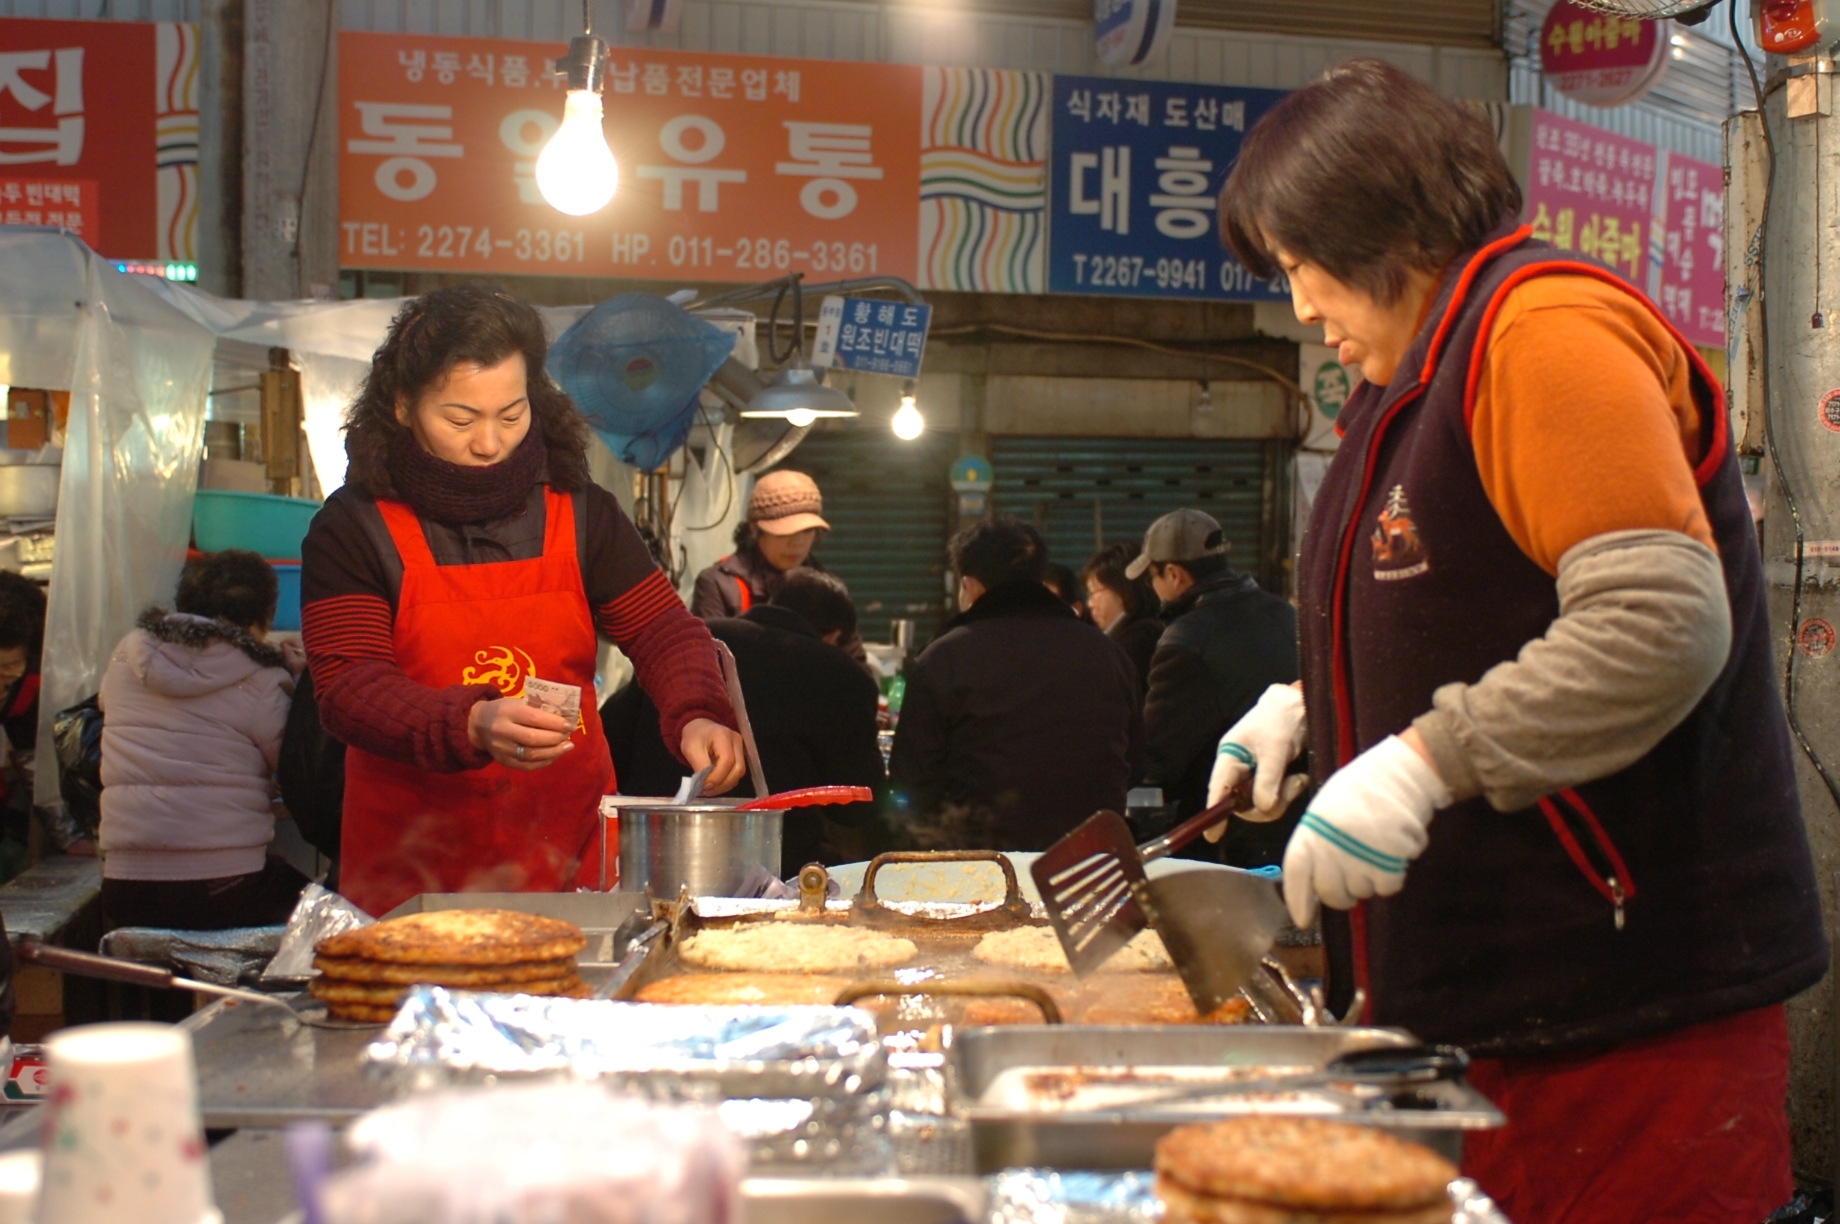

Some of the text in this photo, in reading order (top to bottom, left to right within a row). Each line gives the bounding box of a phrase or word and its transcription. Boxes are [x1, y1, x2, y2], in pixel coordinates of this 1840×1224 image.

[1067, 89, 1246, 132] 식자재 도산매
[1069, 146, 1217, 239] 대흥
[343, 221, 406, 256] TEL:
[417, 224, 586, 263] 2274-3361
[668, 234, 879, 274] 011-286-3361
[854, 302, 919, 327] 황해도
